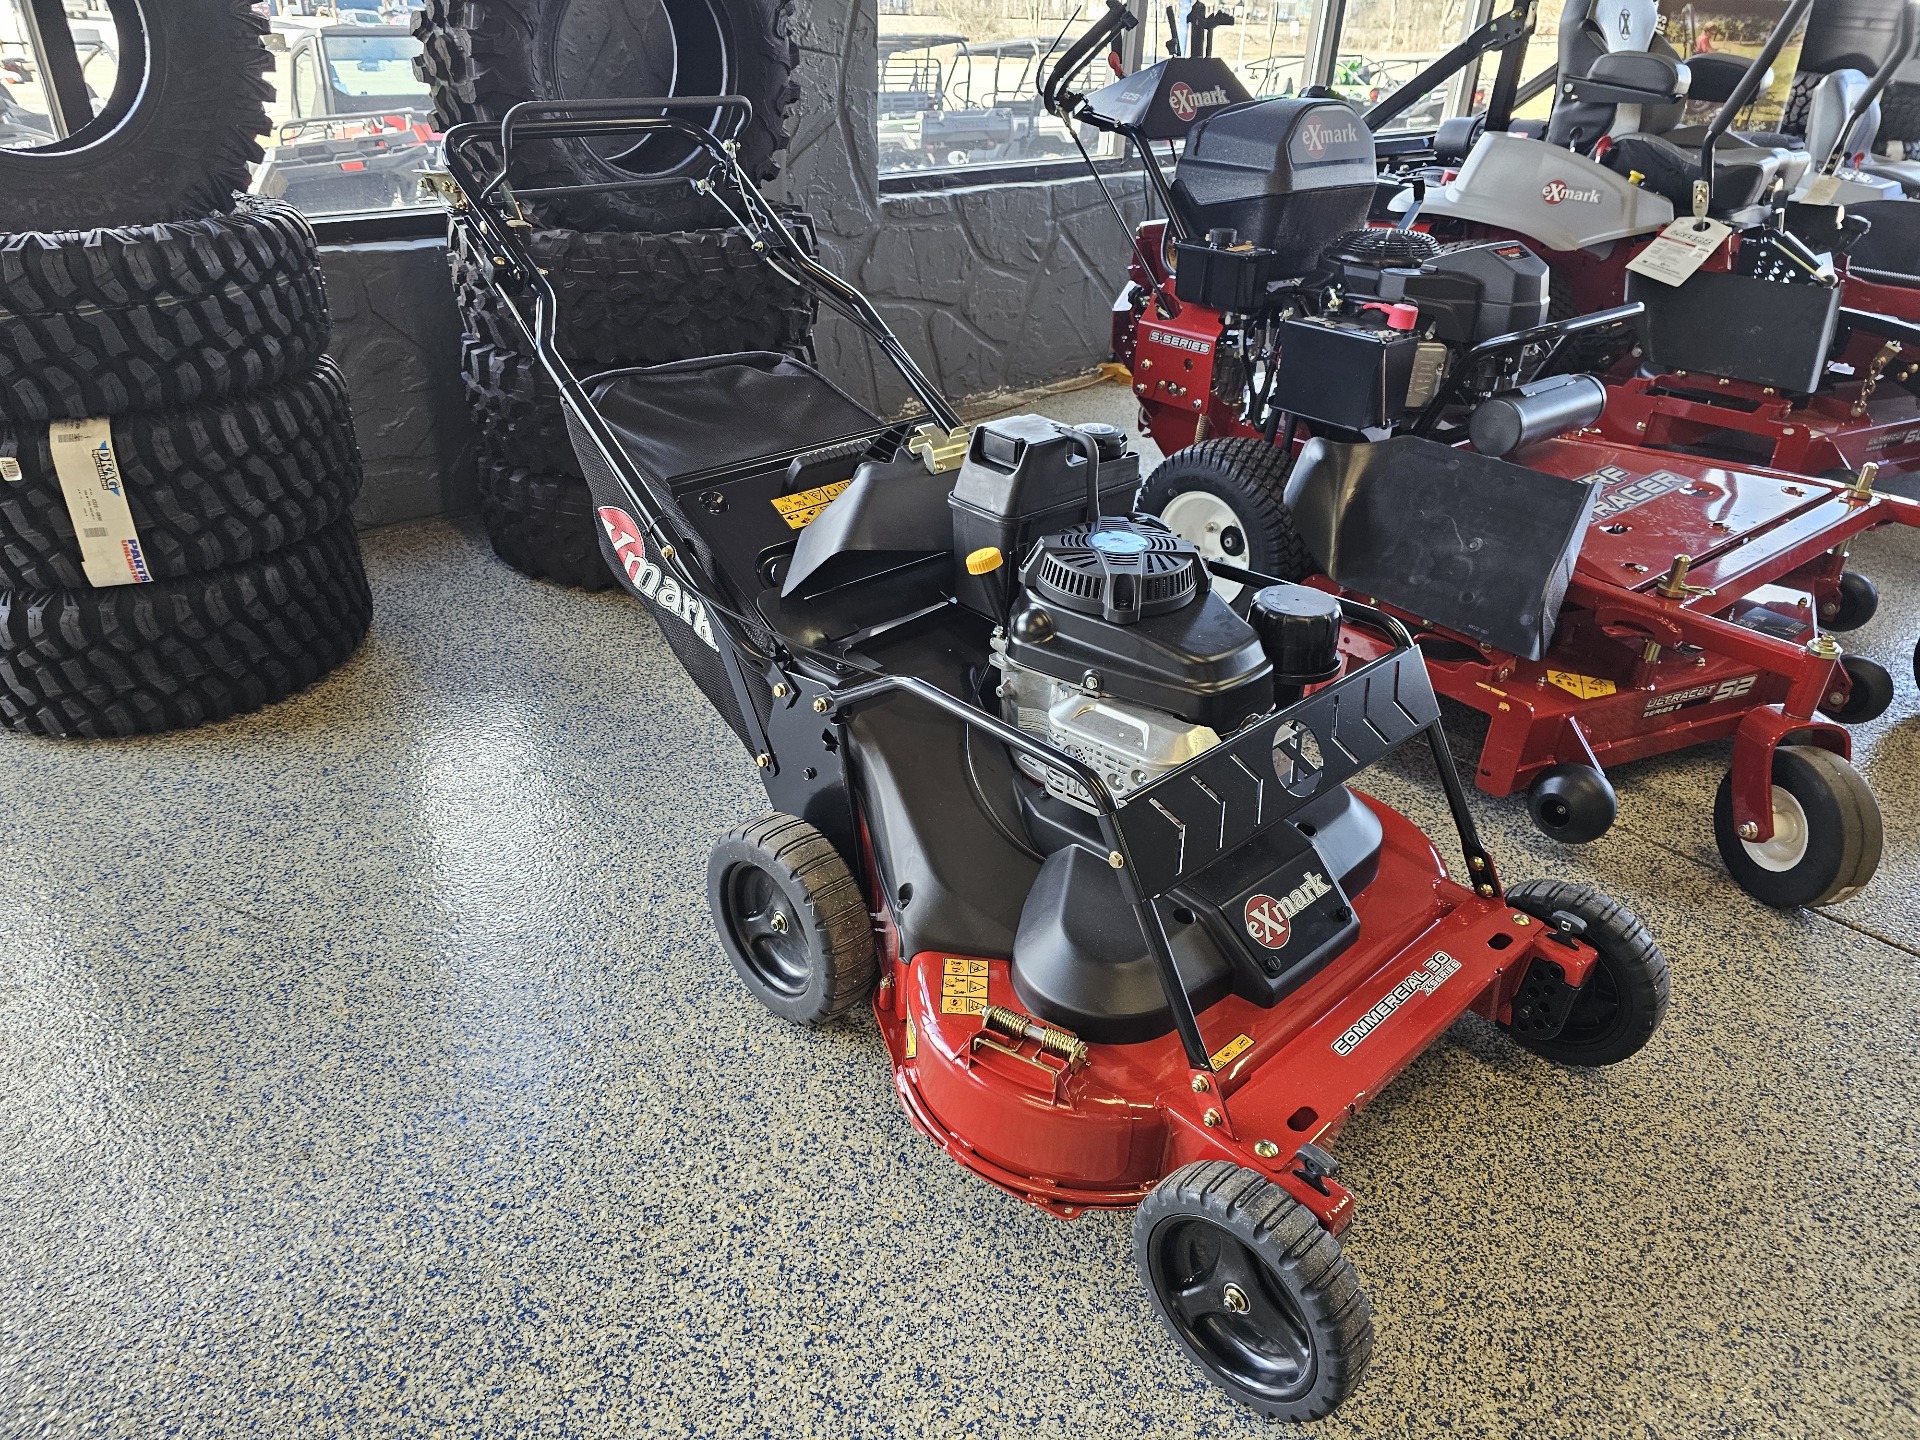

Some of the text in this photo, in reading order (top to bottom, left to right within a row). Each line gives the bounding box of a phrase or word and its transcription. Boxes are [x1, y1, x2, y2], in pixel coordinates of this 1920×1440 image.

[1169, 83, 1230, 117] eXmark
[1303, 121, 1358, 152] eXmark
[1542, 182, 1600, 204] eXmark
[98, 448, 121, 492] DRAG
[1578, 465, 1627, 485] RF
[1591, 471, 1686, 523] RACER
[121, 539, 142, 583] UNLIMITED
[127, 539, 150, 582] PARTS
[1642, 704, 1675, 718] SERIES
[1646, 674, 1758, 709] ULTRACUT 52
[1247, 871, 1333, 944] eXmark
[1331, 951, 1451, 1056] COMMERCIAL 30
